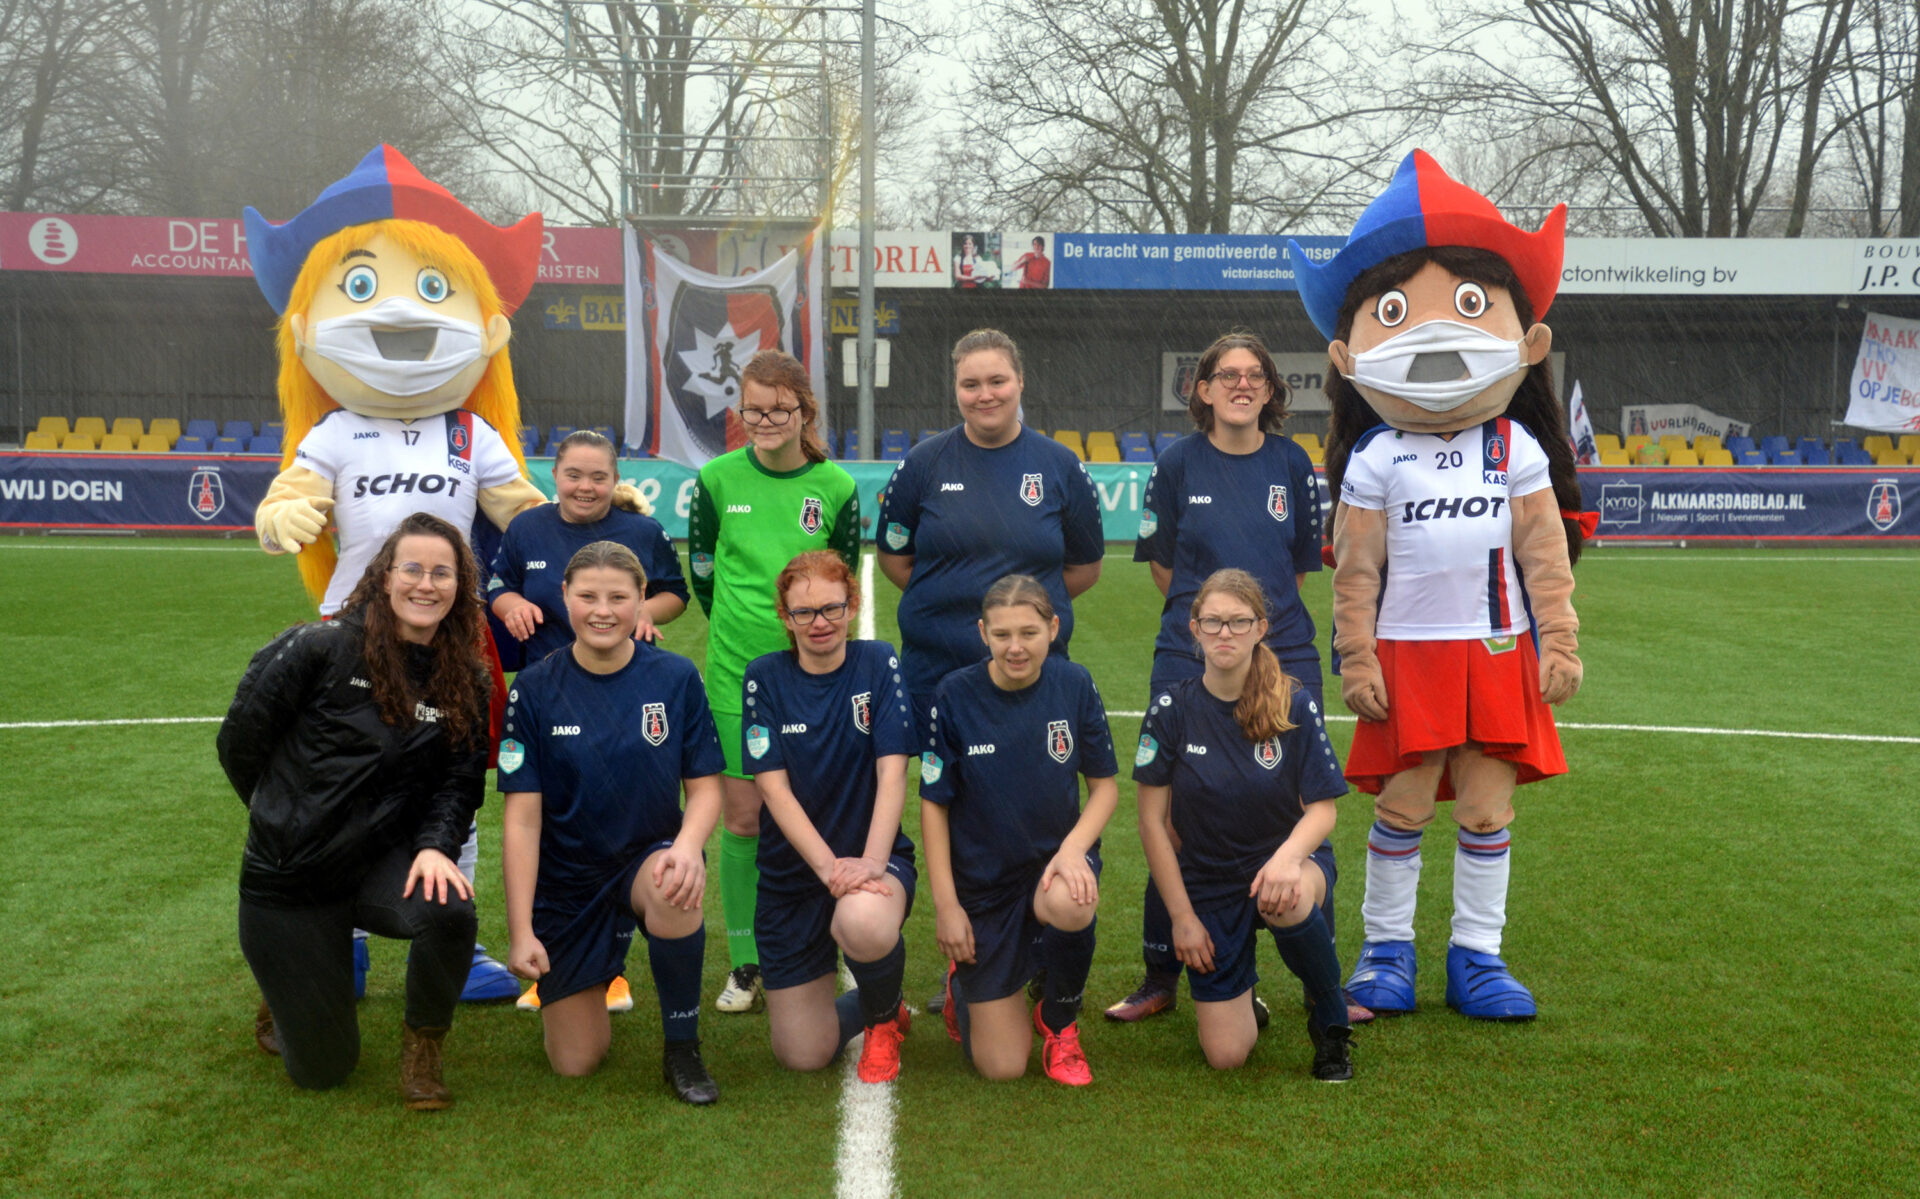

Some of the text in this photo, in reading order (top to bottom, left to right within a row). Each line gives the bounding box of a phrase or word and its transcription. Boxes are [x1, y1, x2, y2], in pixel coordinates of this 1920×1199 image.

[169, 220, 219, 253] DE
[1063, 242, 1084, 258] De
[1088, 242, 1138, 259] kracht
[1142, 246, 1169, 259] van
[1173, 242, 1277, 262] gemotiveerde
[1864, 245, 1920, 259] BOU
[1713, 265, 1738, 283] bv
[1858, 264, 1899, 292] J.P.
[352, 431, 380, 440] JAKO
[401, 430, 421, 446] 17
[1392, 453, 1418, 465] JAKO
[1435, 450, 1463, 470] 20
[1, 479, 123, 501] WIJ DOEN
[353, 473, 461, 498] SCHOT
[940, 483, 964, 492] JAKO
[1605, 497, 1638, 508] XYTO
[726, 504, 751, 514] JAKO
[1402, 496, 1505, 523] SCHOT
[1657, 513, 1785, 523] Nieuws Sport Evenementen
[526, 560, 547, 570] JAKO
[552, 726, 581, 735] JAKO
[781, 723, 807, 734] JAKO
[967, 744, 996, 756] JAKO
[1186, 744, 1207, 755] AKO
